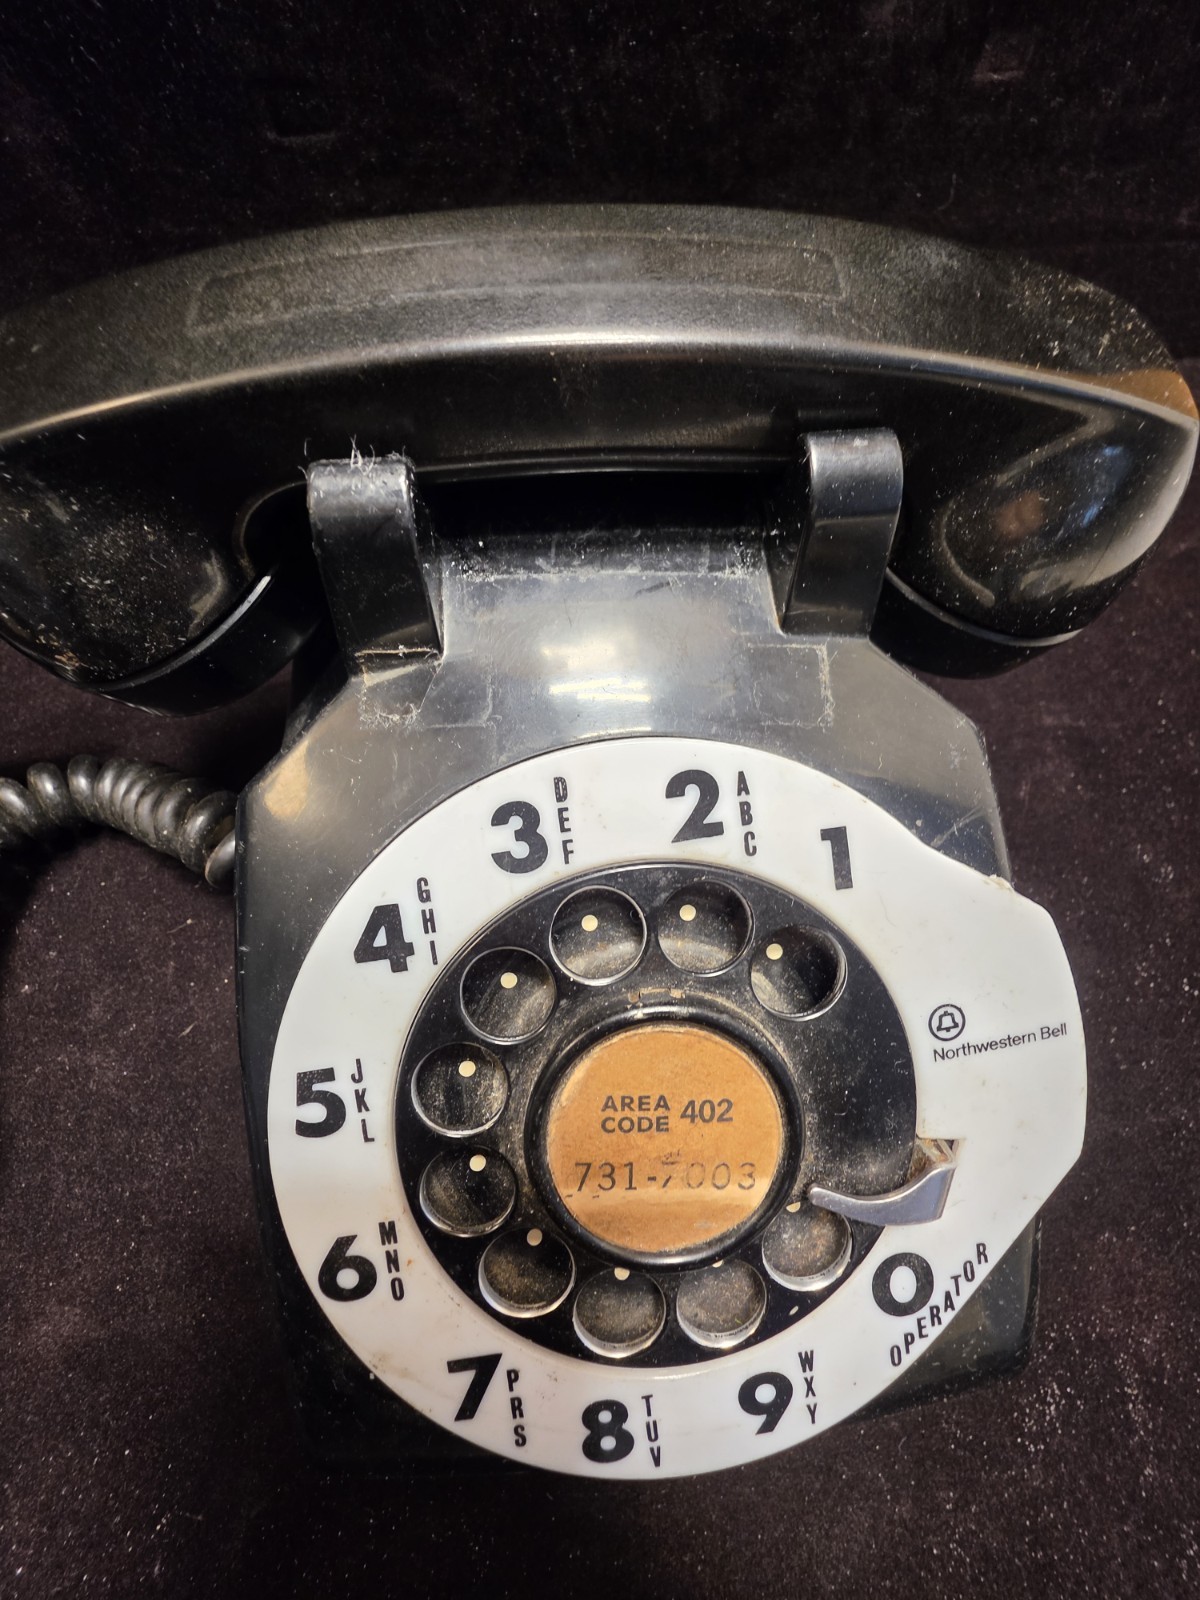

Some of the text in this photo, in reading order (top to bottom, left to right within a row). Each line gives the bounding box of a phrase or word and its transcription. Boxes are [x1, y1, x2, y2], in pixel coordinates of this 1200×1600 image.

[490, 800, 549, 873] 3
[665, 769, 724, 843] 2
[820, 826, 853, 890] 1
[353, 903, 414, 973] 4
[933, 1023, 1068, 1062] Northwestern Bell
[295, 1067, 347, 1138] 5
[600, 1116, 670, 1134] CODE
[601, 1094, 734, 1124] AREA 402
[318, 1234, 377, 1302] 6
[890, 1242, 989, 1367] OPERATOR
[446, 1353, 503, 1422] 7
[738, 1371, 794, 1436] 9
[581, 1399, 635, 1463] 8
